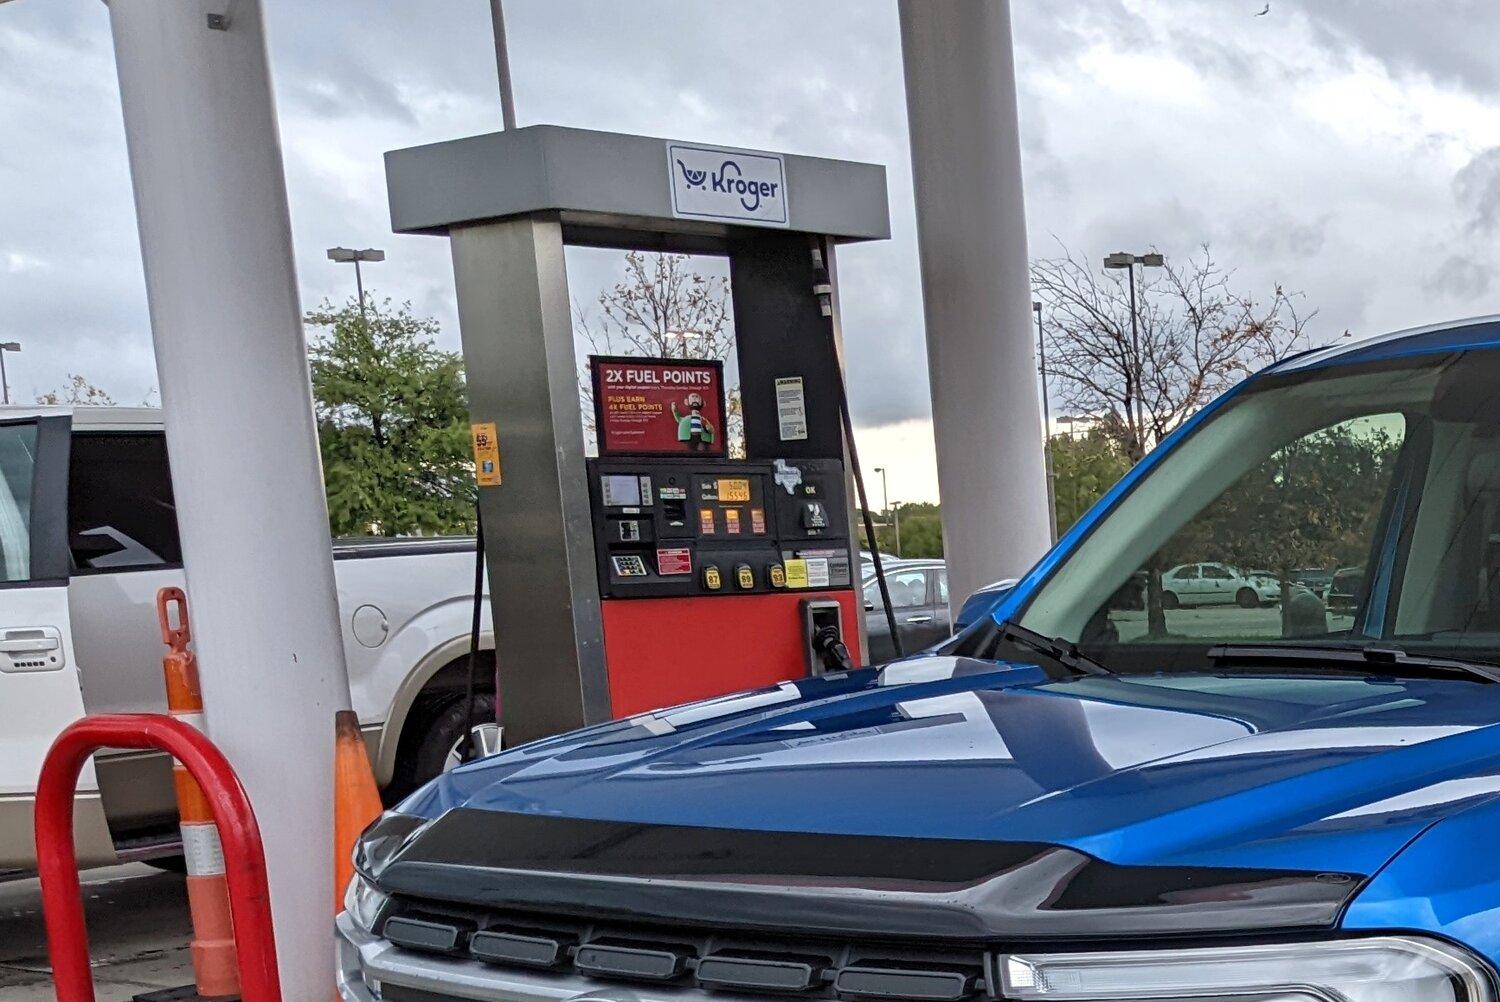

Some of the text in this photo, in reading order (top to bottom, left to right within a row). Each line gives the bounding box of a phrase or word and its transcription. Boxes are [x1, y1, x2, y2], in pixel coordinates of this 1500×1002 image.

[711, 160, 778, 212] Kroger
[605, 369, 712, 385] 2X FUEL POINTS
[638, 404, 663, 412] POINTS
[804, 486, 816, 494] OK
[708, 575, 718, 584] 87
[741, 575, 751, 583] 89
